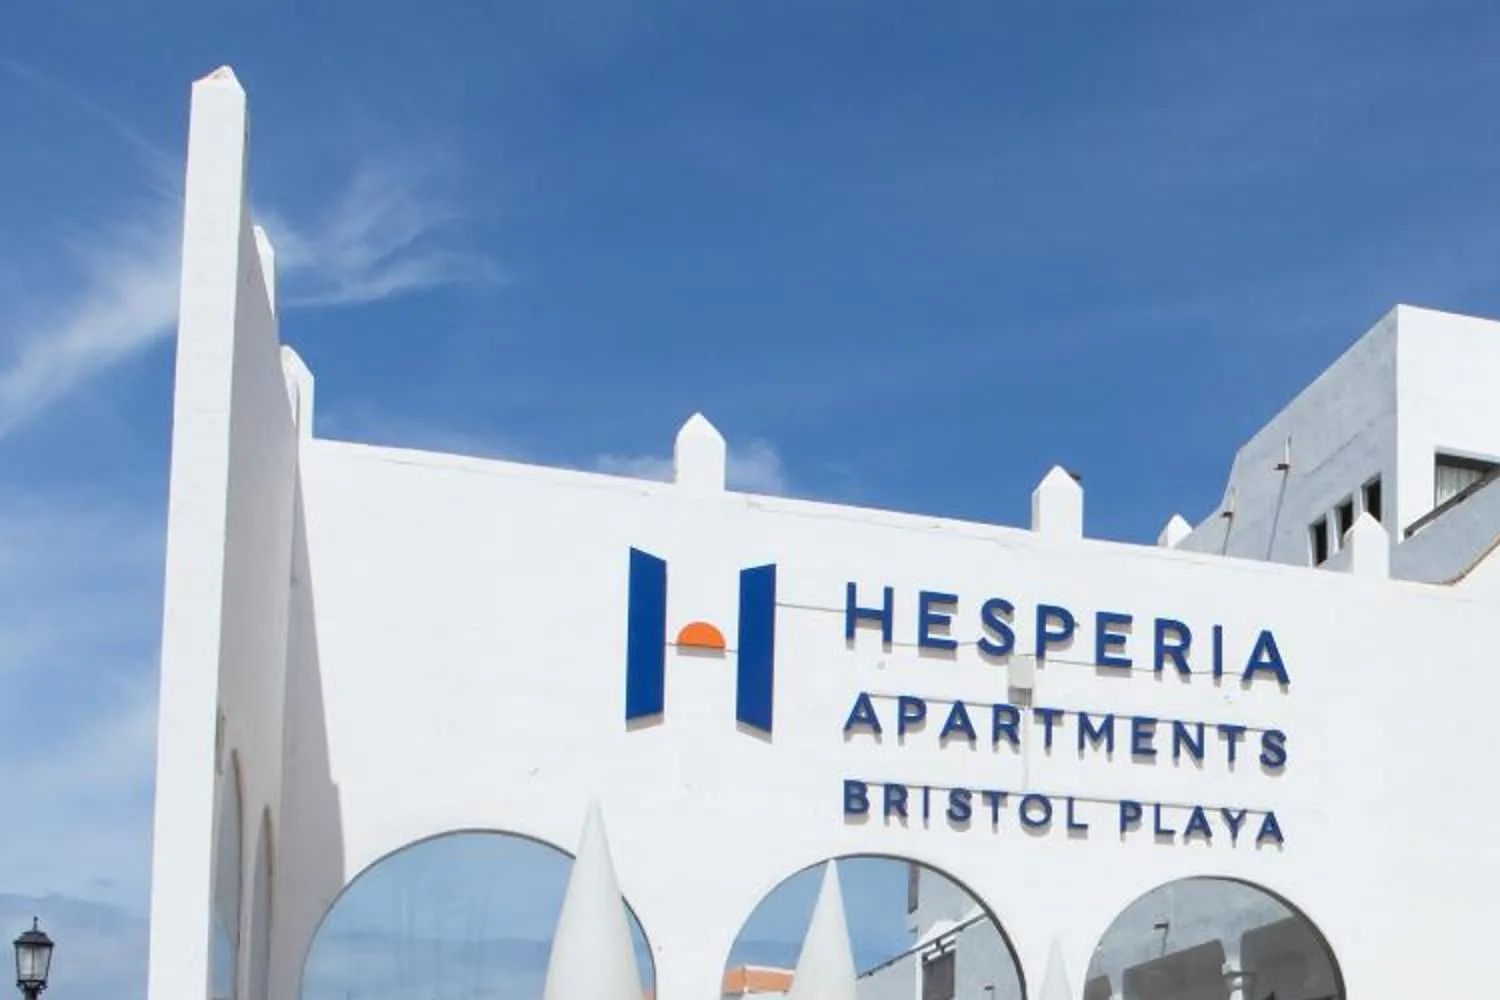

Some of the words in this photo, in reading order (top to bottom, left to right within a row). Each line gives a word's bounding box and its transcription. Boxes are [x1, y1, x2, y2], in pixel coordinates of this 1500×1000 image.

[845, 581, 1290, 685] HESPERIA
[843, 692, 1288, 769] APARTMENTS
[843, 779, 1089, 831] BRISTOL
[1119, 799, 1285, 846] PLAYA
